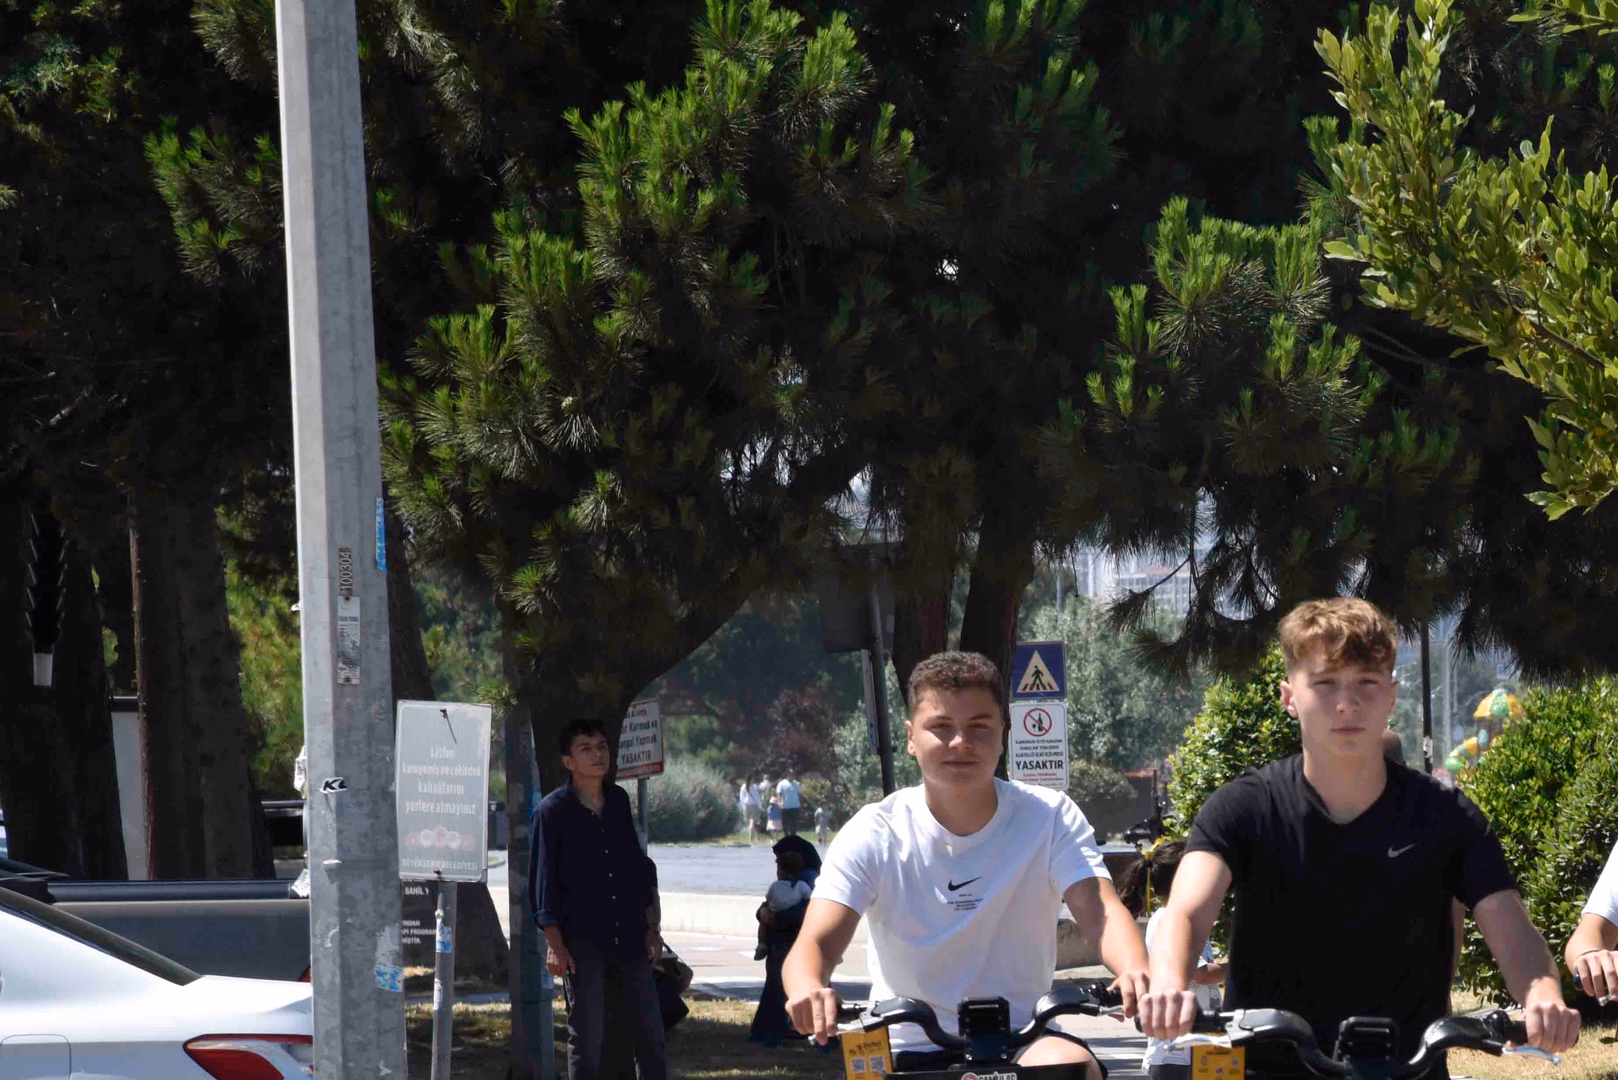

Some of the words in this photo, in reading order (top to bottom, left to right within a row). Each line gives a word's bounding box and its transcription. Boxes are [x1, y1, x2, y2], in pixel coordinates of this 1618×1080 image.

[340, 551, 352, 590] 100304
[629, 720, 650, 732] Kurmak
[619, 736, 635, 750] angal
[636, 733, 656, 747] Yapmak
[621, 750, 652, 765] YASAKTIR
[1015, 760, 1064, 770] YASAKTIR
